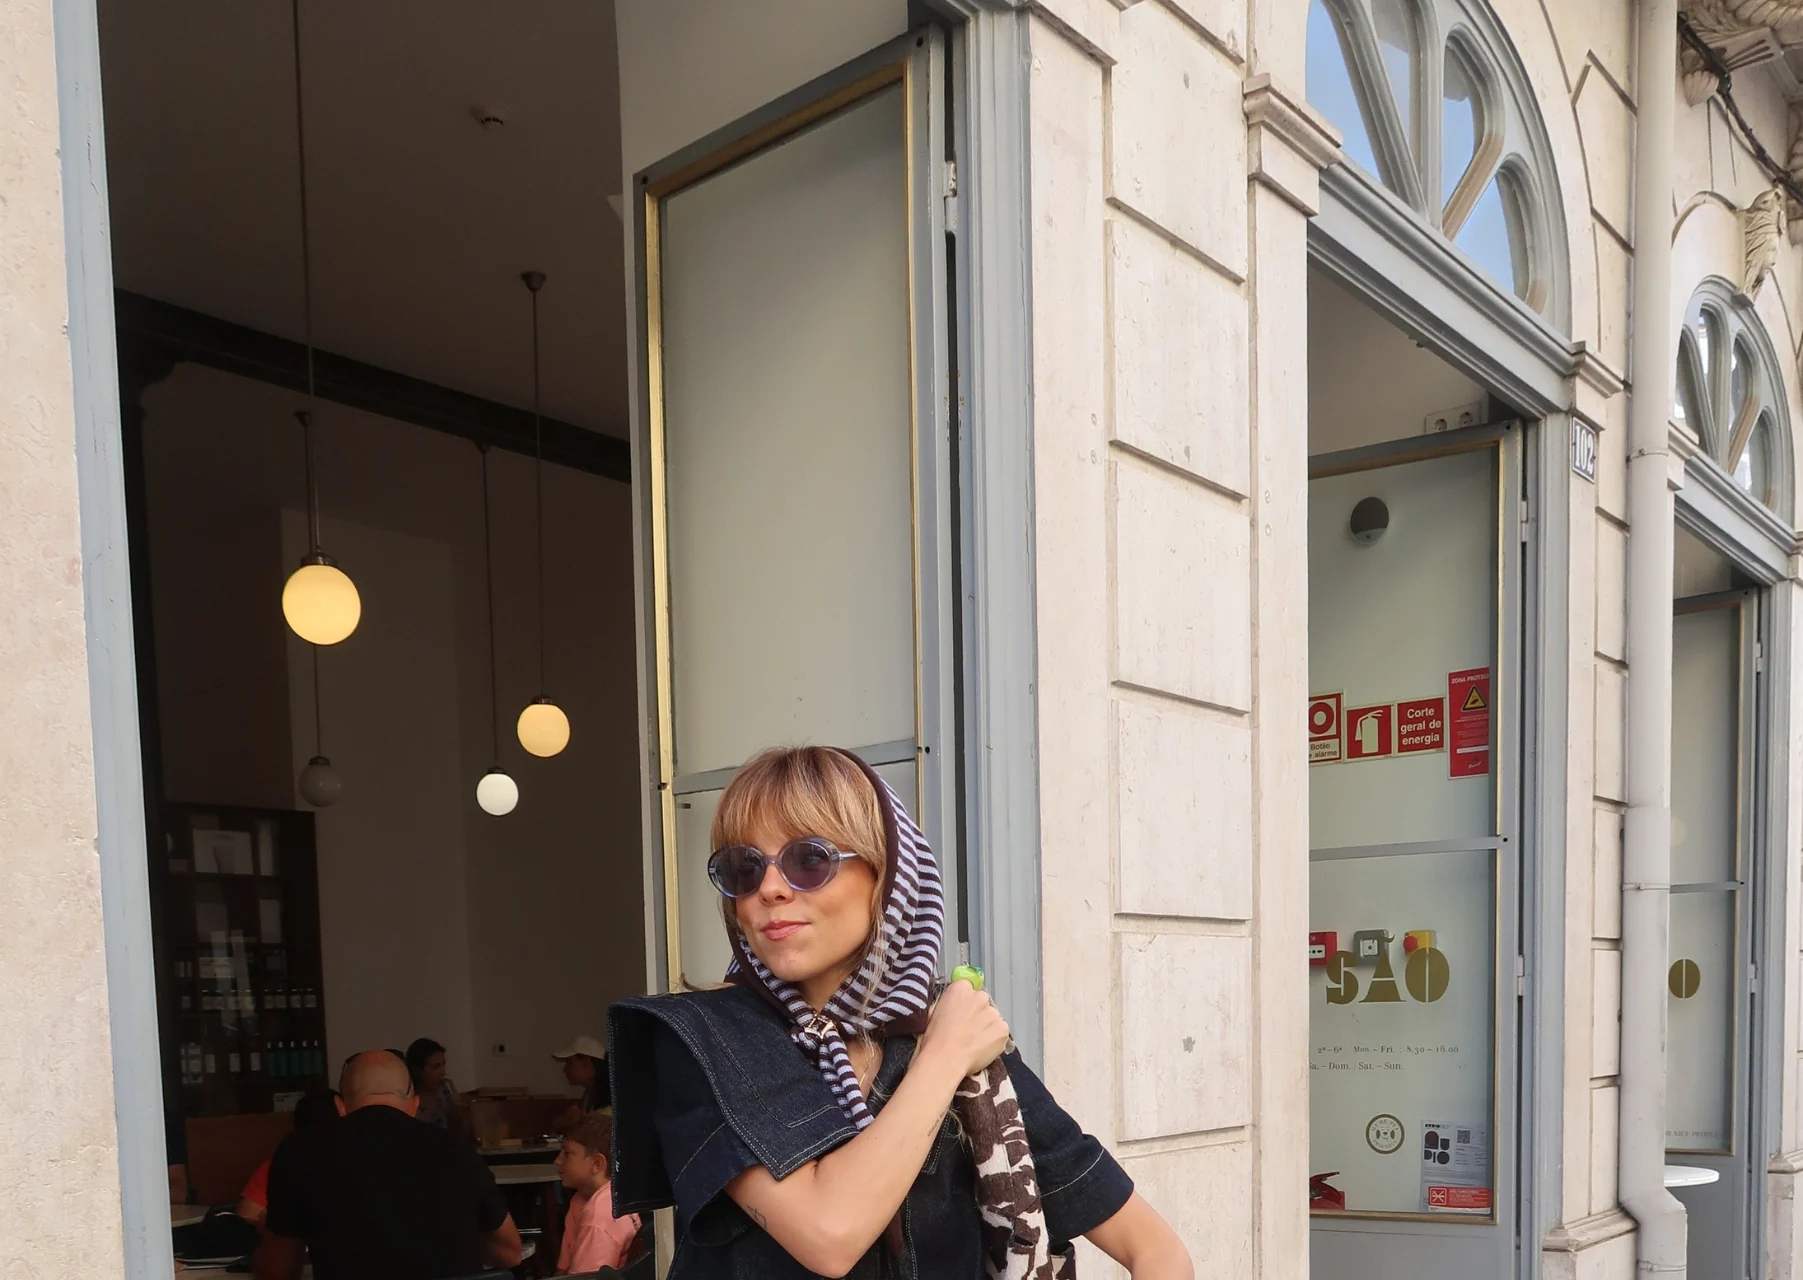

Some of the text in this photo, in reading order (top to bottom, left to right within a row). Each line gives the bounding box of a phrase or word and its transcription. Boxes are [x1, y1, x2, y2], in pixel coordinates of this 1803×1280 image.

[1575, 425, 1594, 475] 102
[1407, 707, 1435, 719] Corte
[1400, 718, 1442, 735] geral de
[1402, 732, 1440, 746] energia
[1310, 743, 1331, 751] Botão
[1315, 750, 1338, 758] alarme
[1326, 934, 1450, 1005] SÃO
